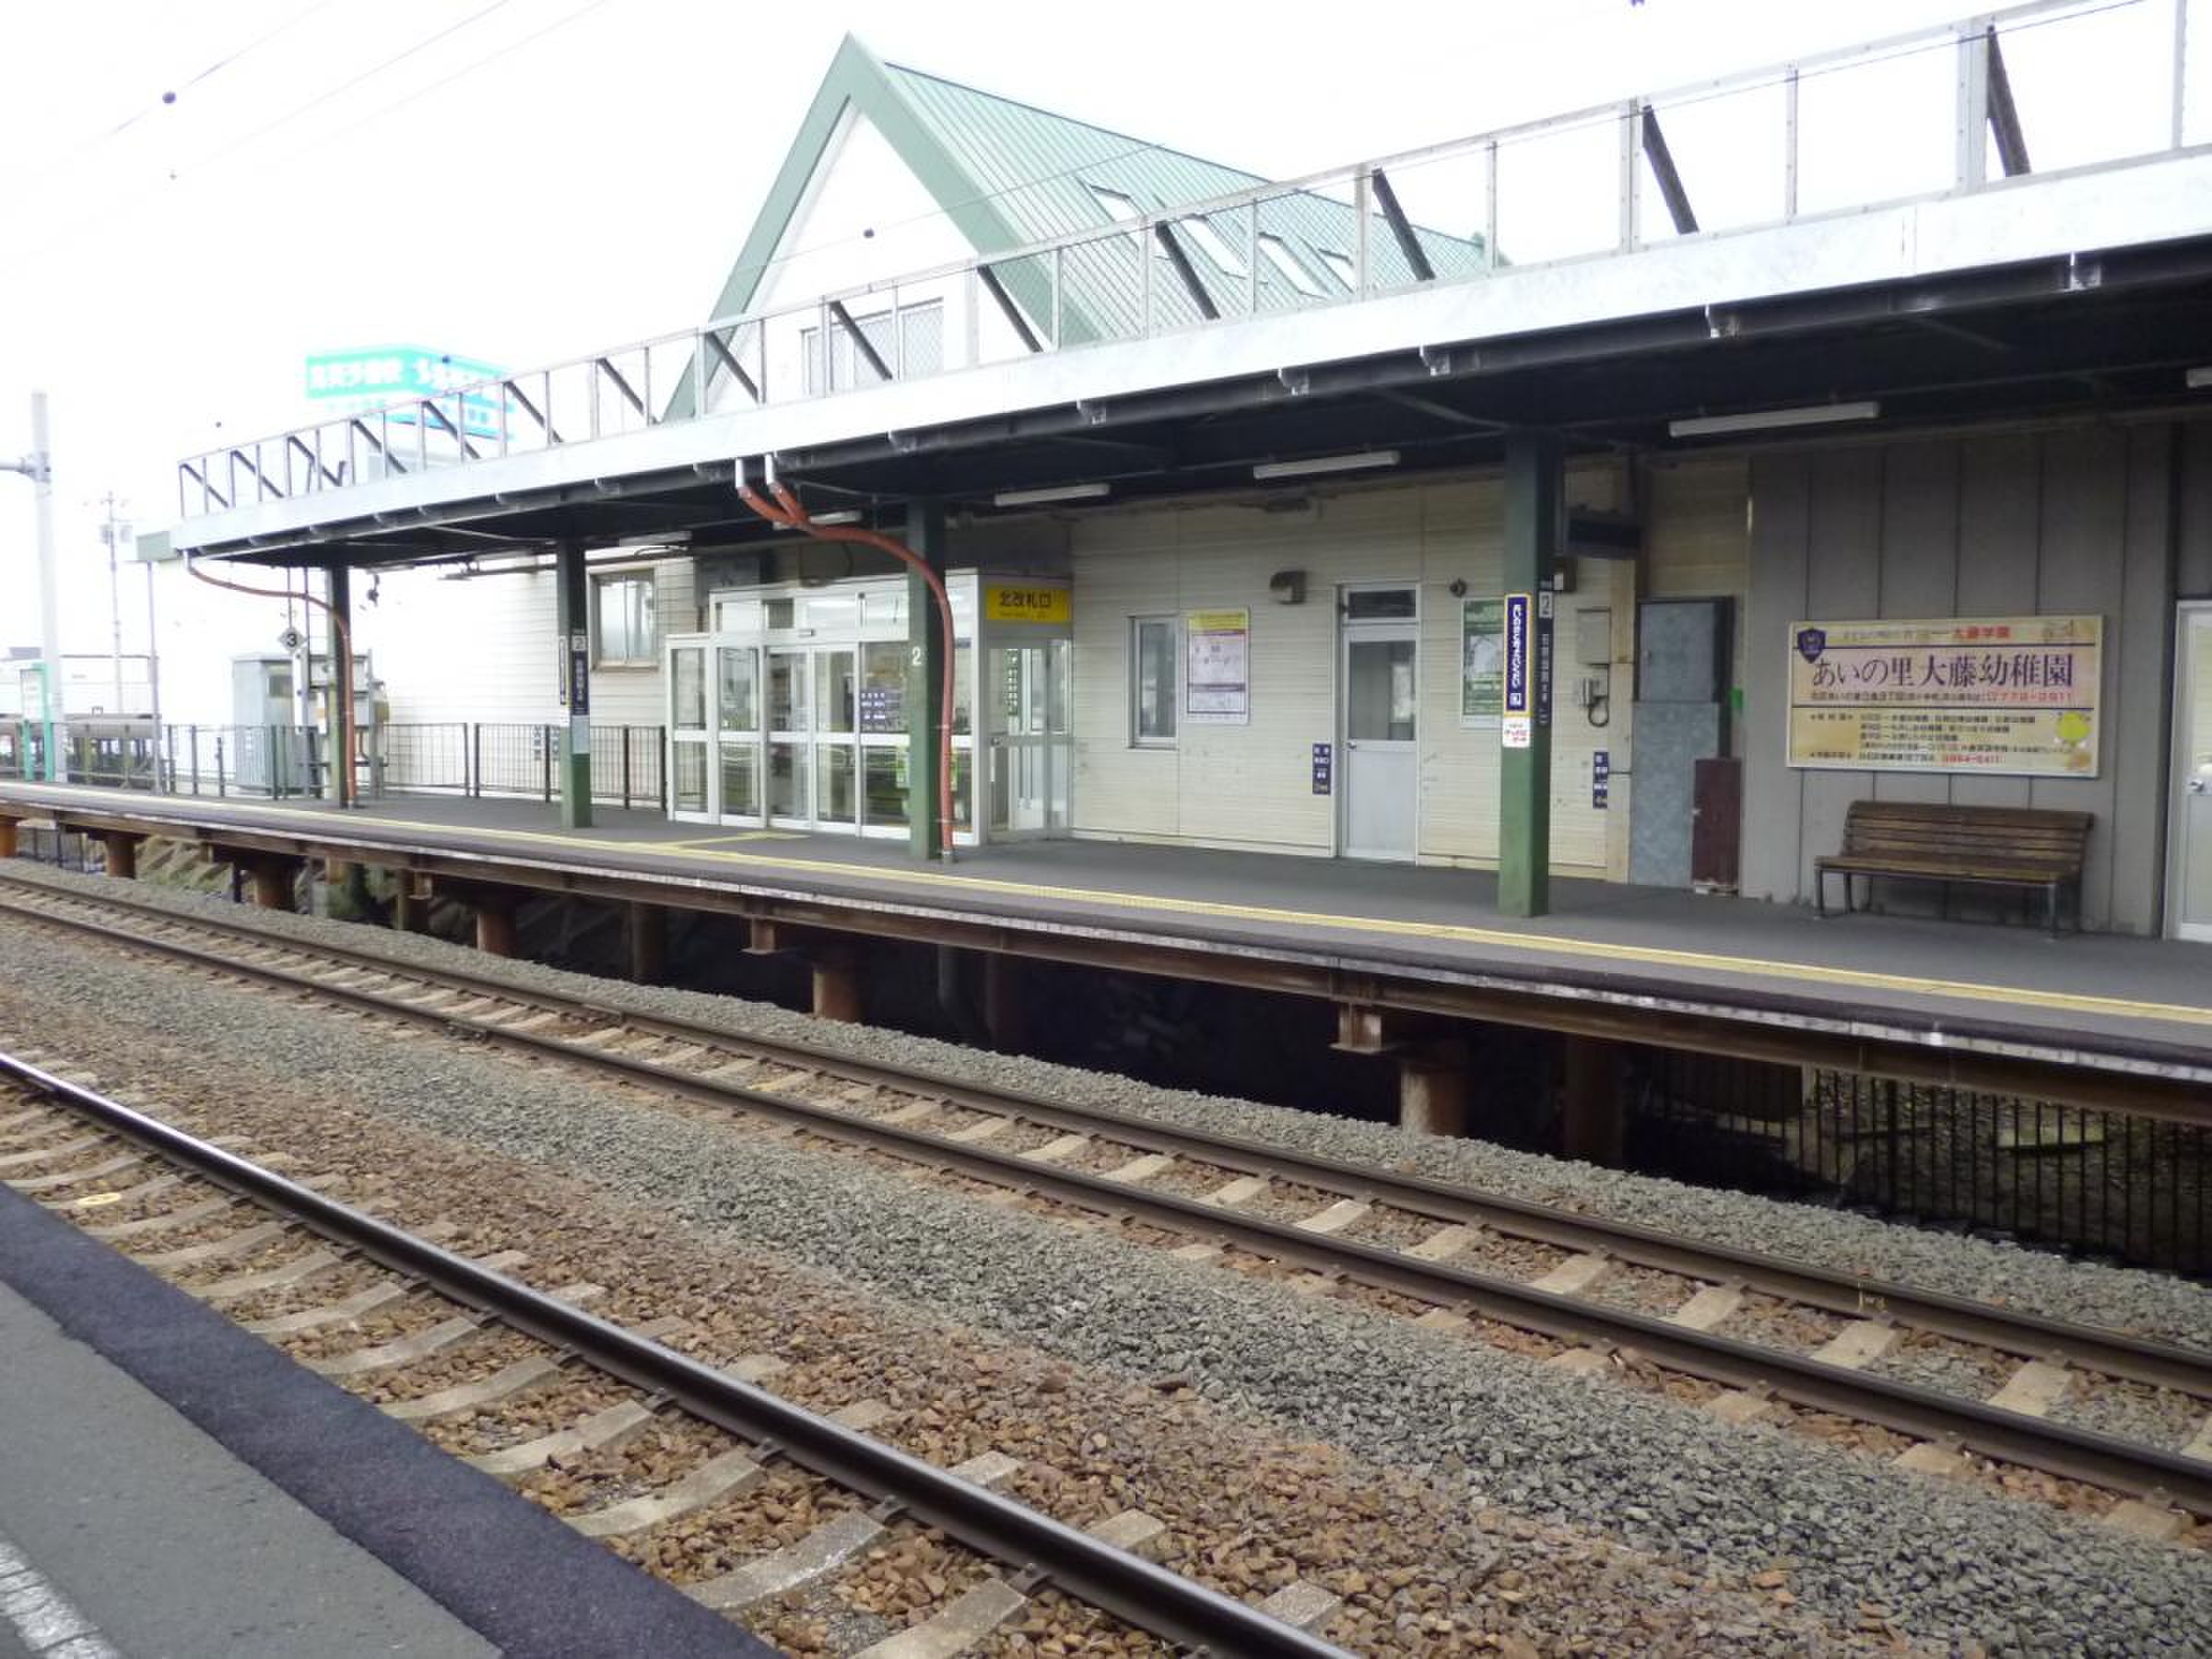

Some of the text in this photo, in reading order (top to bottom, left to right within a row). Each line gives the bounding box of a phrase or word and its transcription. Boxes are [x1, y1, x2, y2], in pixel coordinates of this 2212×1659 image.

[287, 632, 297, 648] 3
[912, 647, 922, 665] 2
[1812, 653, 2073, 688] あいの里大藤幼稚園
